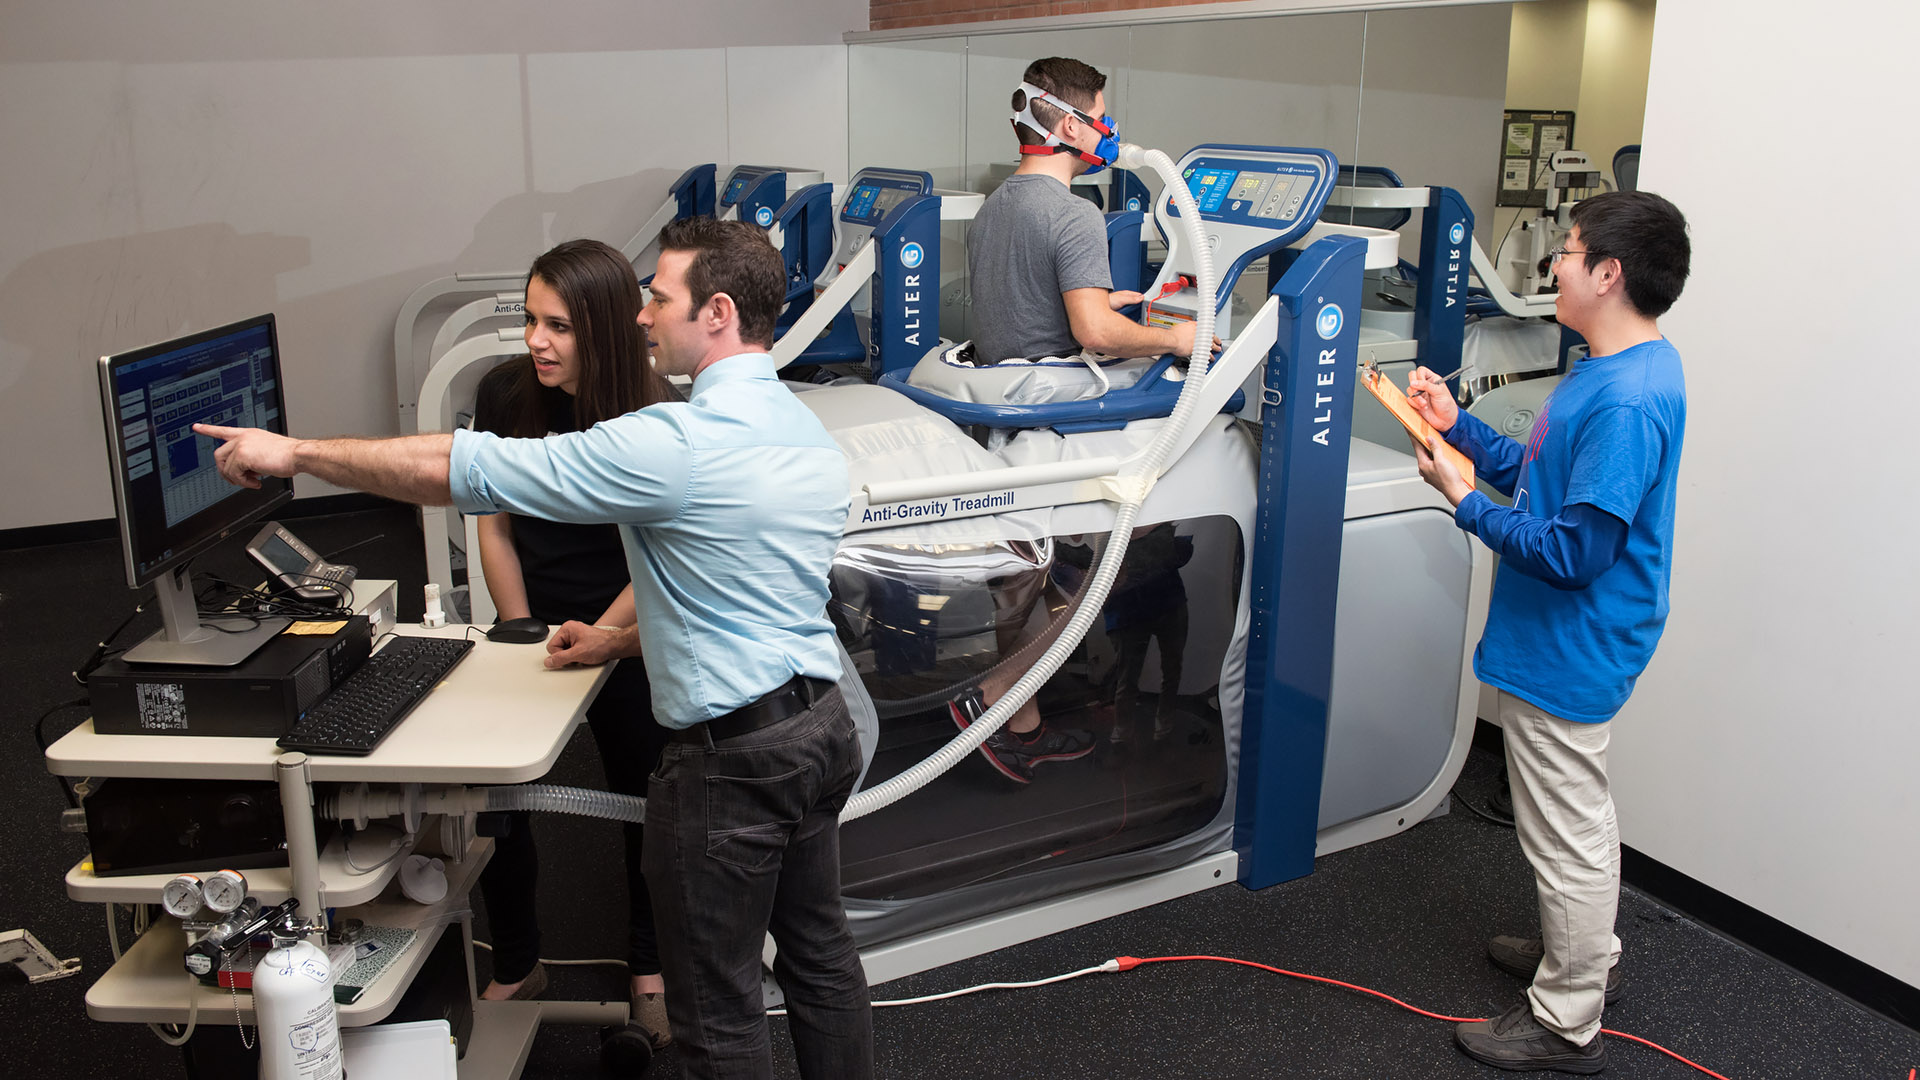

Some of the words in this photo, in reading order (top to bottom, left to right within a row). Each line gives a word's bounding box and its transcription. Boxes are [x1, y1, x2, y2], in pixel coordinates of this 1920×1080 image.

[494, 304, 525, 313] Anti-Gr
[904, 274, 920, 346] ALTER
[1312, 348, 1338, 446] ALTER
[862, 501, 948, 523] Anti-Gravity
[952, 490, 1015, 512] Treadmill
